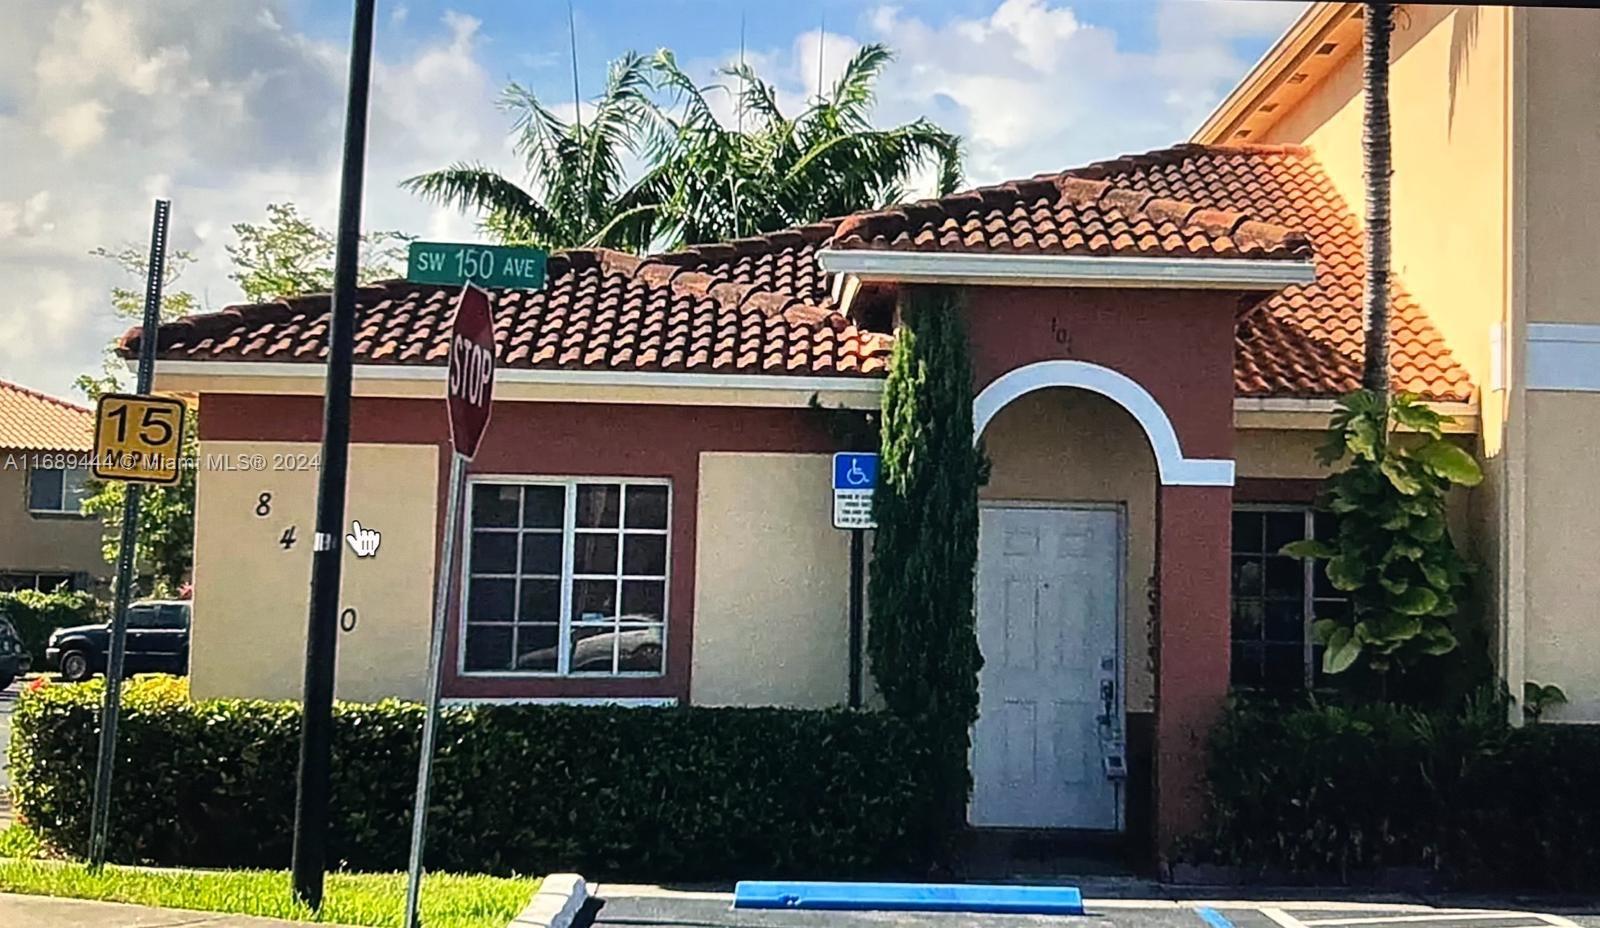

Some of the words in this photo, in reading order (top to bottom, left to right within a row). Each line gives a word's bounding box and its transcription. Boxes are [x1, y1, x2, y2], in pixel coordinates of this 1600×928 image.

[417, 252, 446, 271] SW
[455, 249, 494, 279] 150
[502, 257, 535, 278] AVE
[452, 333, 492, 408] STOP
[108, 404, 173, 446] 15
